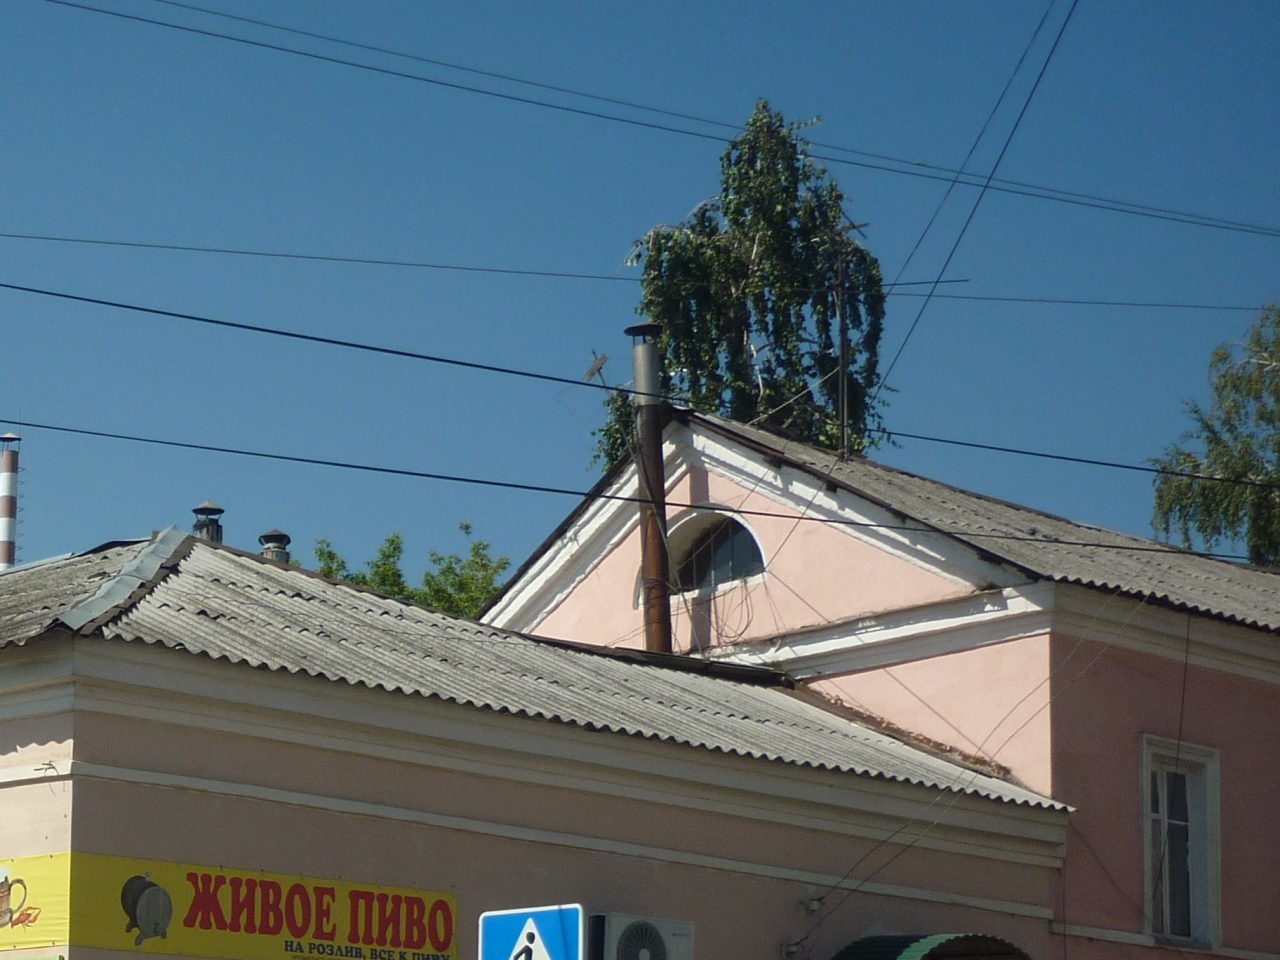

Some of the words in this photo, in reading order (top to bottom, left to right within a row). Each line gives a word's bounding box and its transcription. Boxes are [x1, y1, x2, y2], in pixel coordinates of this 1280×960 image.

[183, 871, 337, 941] ЖИВОЕ
[347, 889, 454, 952] ПИВО
[284, 940, 304, 953] НА
[308, 942, 367, 960] РОЗЛИВ,
